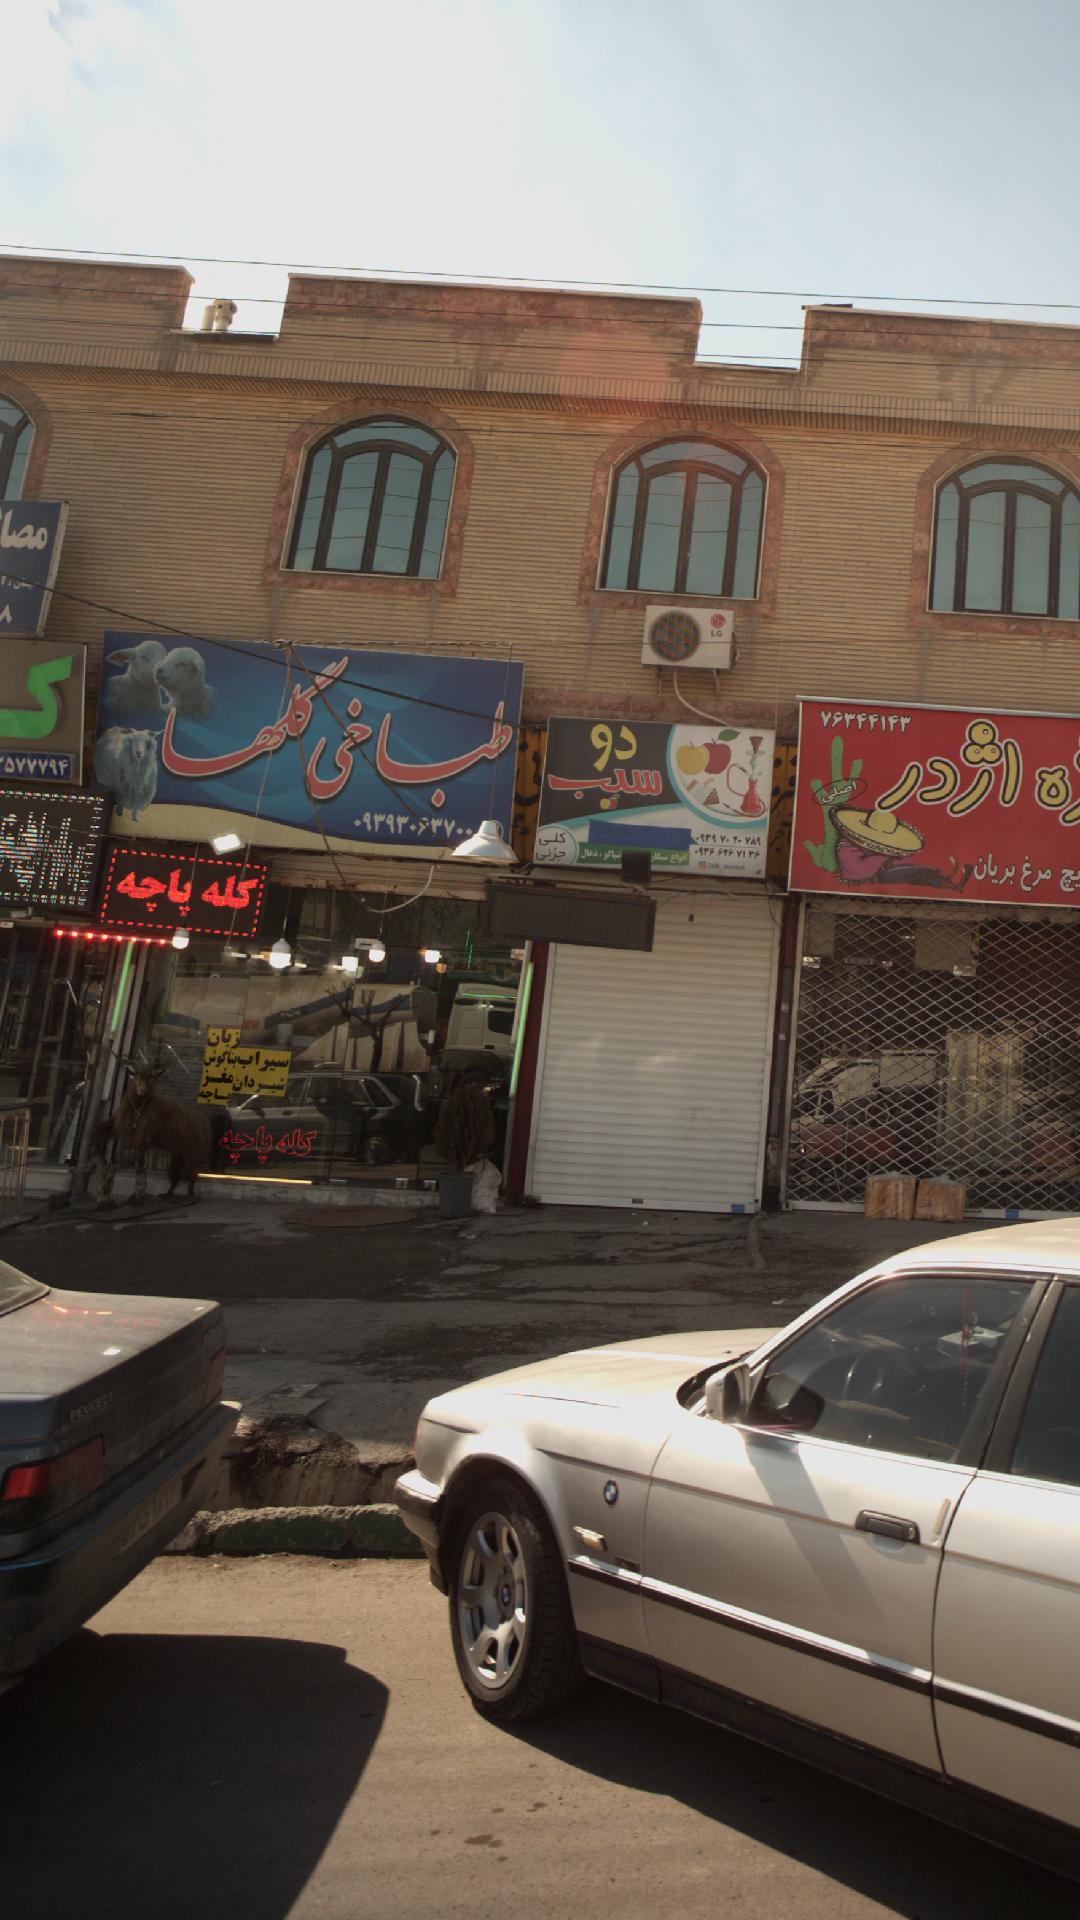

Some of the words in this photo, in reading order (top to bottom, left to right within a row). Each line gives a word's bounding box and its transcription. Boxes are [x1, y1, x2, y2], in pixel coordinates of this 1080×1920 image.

[0, 508, 48, 550] مصا
[711, 629, 723, 638] LG
[161, 655, 350, 778] گلها
[820, 710, 912, 733] ۷۶۳۴۴۱۴۳
[307, 698, 513, 808] طباخی
[590, 723, 638, 773] دو
[875, 719, 1023, 818] اژدر
[547, 768, 663, 810] سیب
[822, 781, 857, 804] اصلی
[973, 853, 1015, 885] بریان
[1020, 855, 1052, 892] مرغ
[116, 868, 193, 918] پاچه
[201, 874, 259, 909] کله
[218, 1124, 274, 1165] پاچه
[275, 1128, 318, 1158] کله
